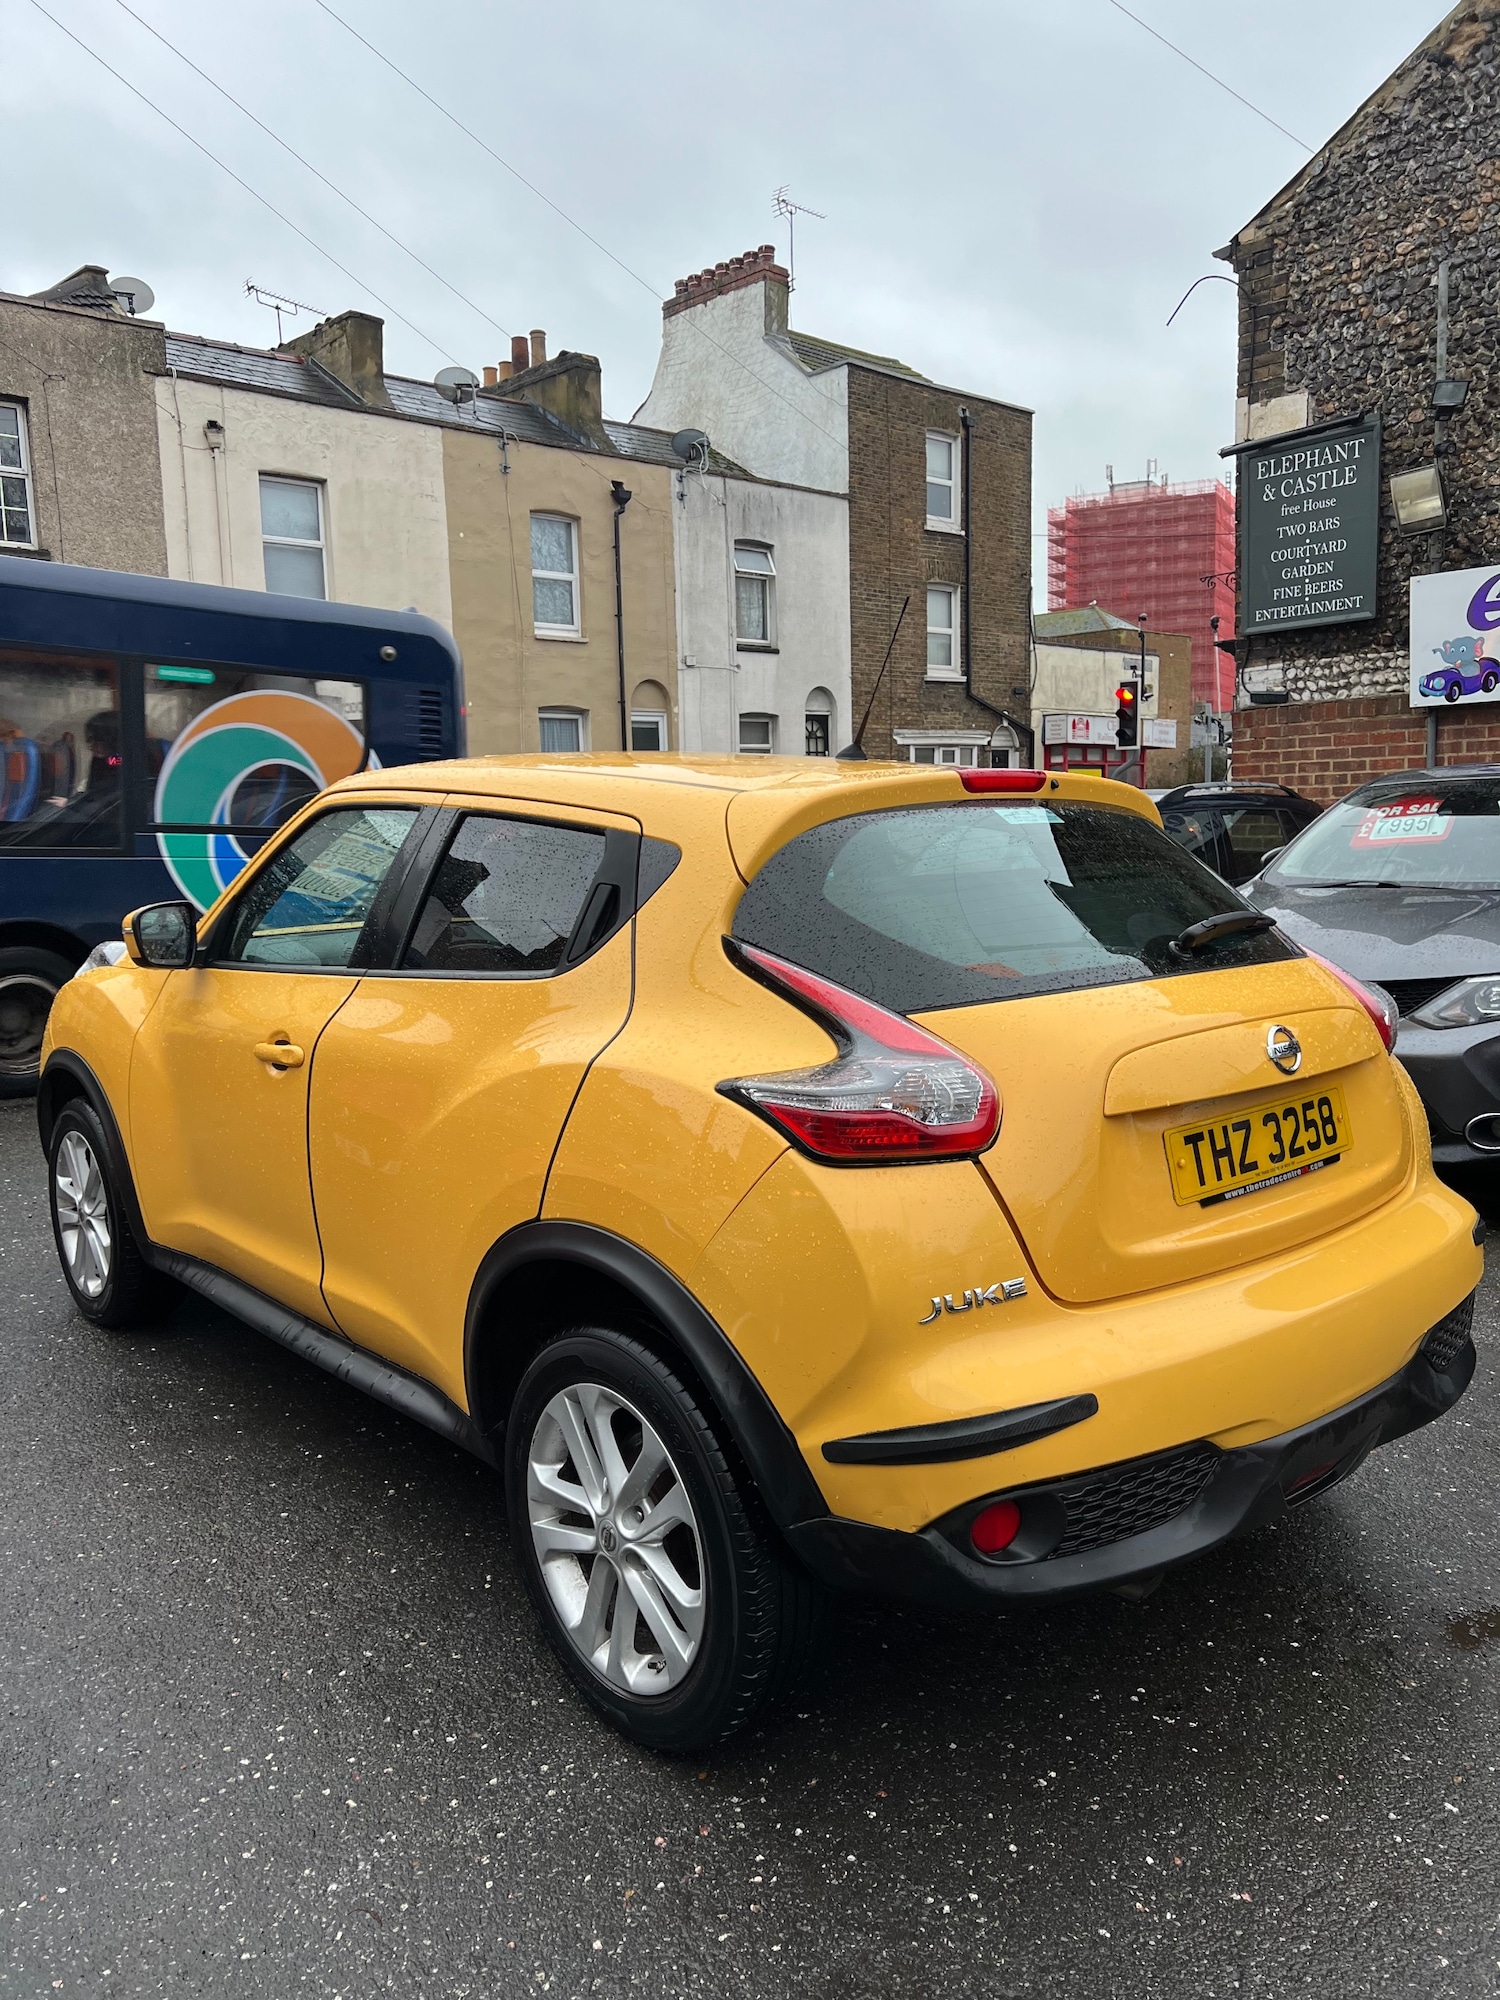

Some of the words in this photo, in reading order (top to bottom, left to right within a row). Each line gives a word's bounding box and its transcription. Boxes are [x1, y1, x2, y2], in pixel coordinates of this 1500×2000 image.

[1257, 438, 1365, 480] ELEPHANT
[1262, 484, 1276, 502] &
[1280, 465, 1357, 498] CASTLE
[1281, 503, 1300, 517] free
[1303, 497, 1337, 513] House
[1277, 523, 1306, 539] TWO
[1309, 516, 1340, 534] BARS
[1270, 538, 1347, 563] COURTYARD
[1281, 560, 1335, 580] GARDEN
[1273, 585, 1302, 601] FINE
[1304, 578, 1344, 596] BEERS
[1255, 595, 1364, 622] ENTERTAINMENT
[1366, 806, 1404, 819] FOR
[1406, 802, 1440, 815] SAL
[1183, 1119, 1259, 1187] THZ
[1262, 1096, 1338, 1164] 3258
[918, 1276, 1029, 1325] JUKE
